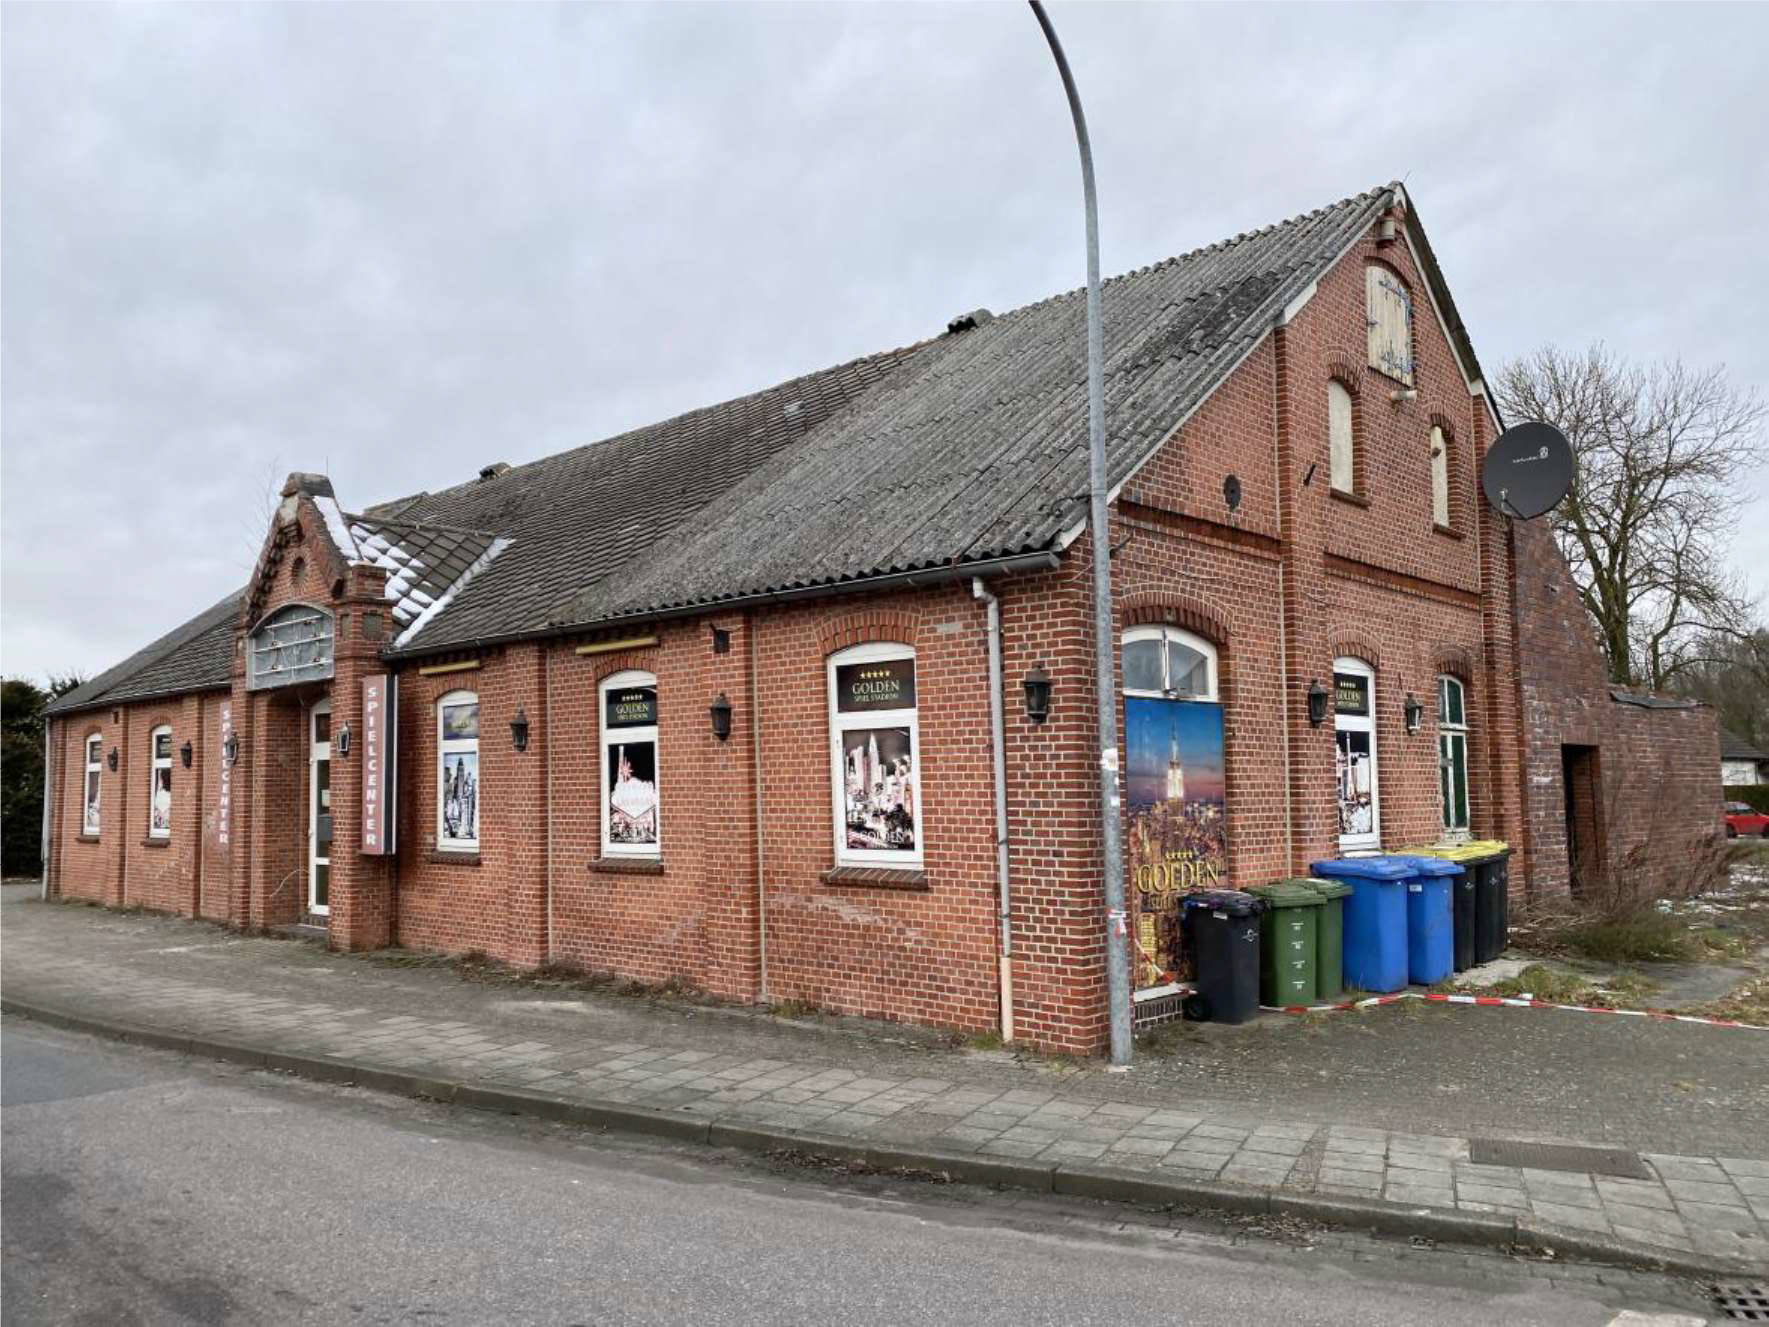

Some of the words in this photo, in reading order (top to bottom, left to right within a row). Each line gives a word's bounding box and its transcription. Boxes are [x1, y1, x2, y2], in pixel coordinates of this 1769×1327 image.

[852, 680, 900, 694] GOLDEN
[616, 702, 649, 714] GOLDEN
[366, 687, 379, 846] SPIELCENTER
[1137, 860, 1219, 893] GOLDEN
